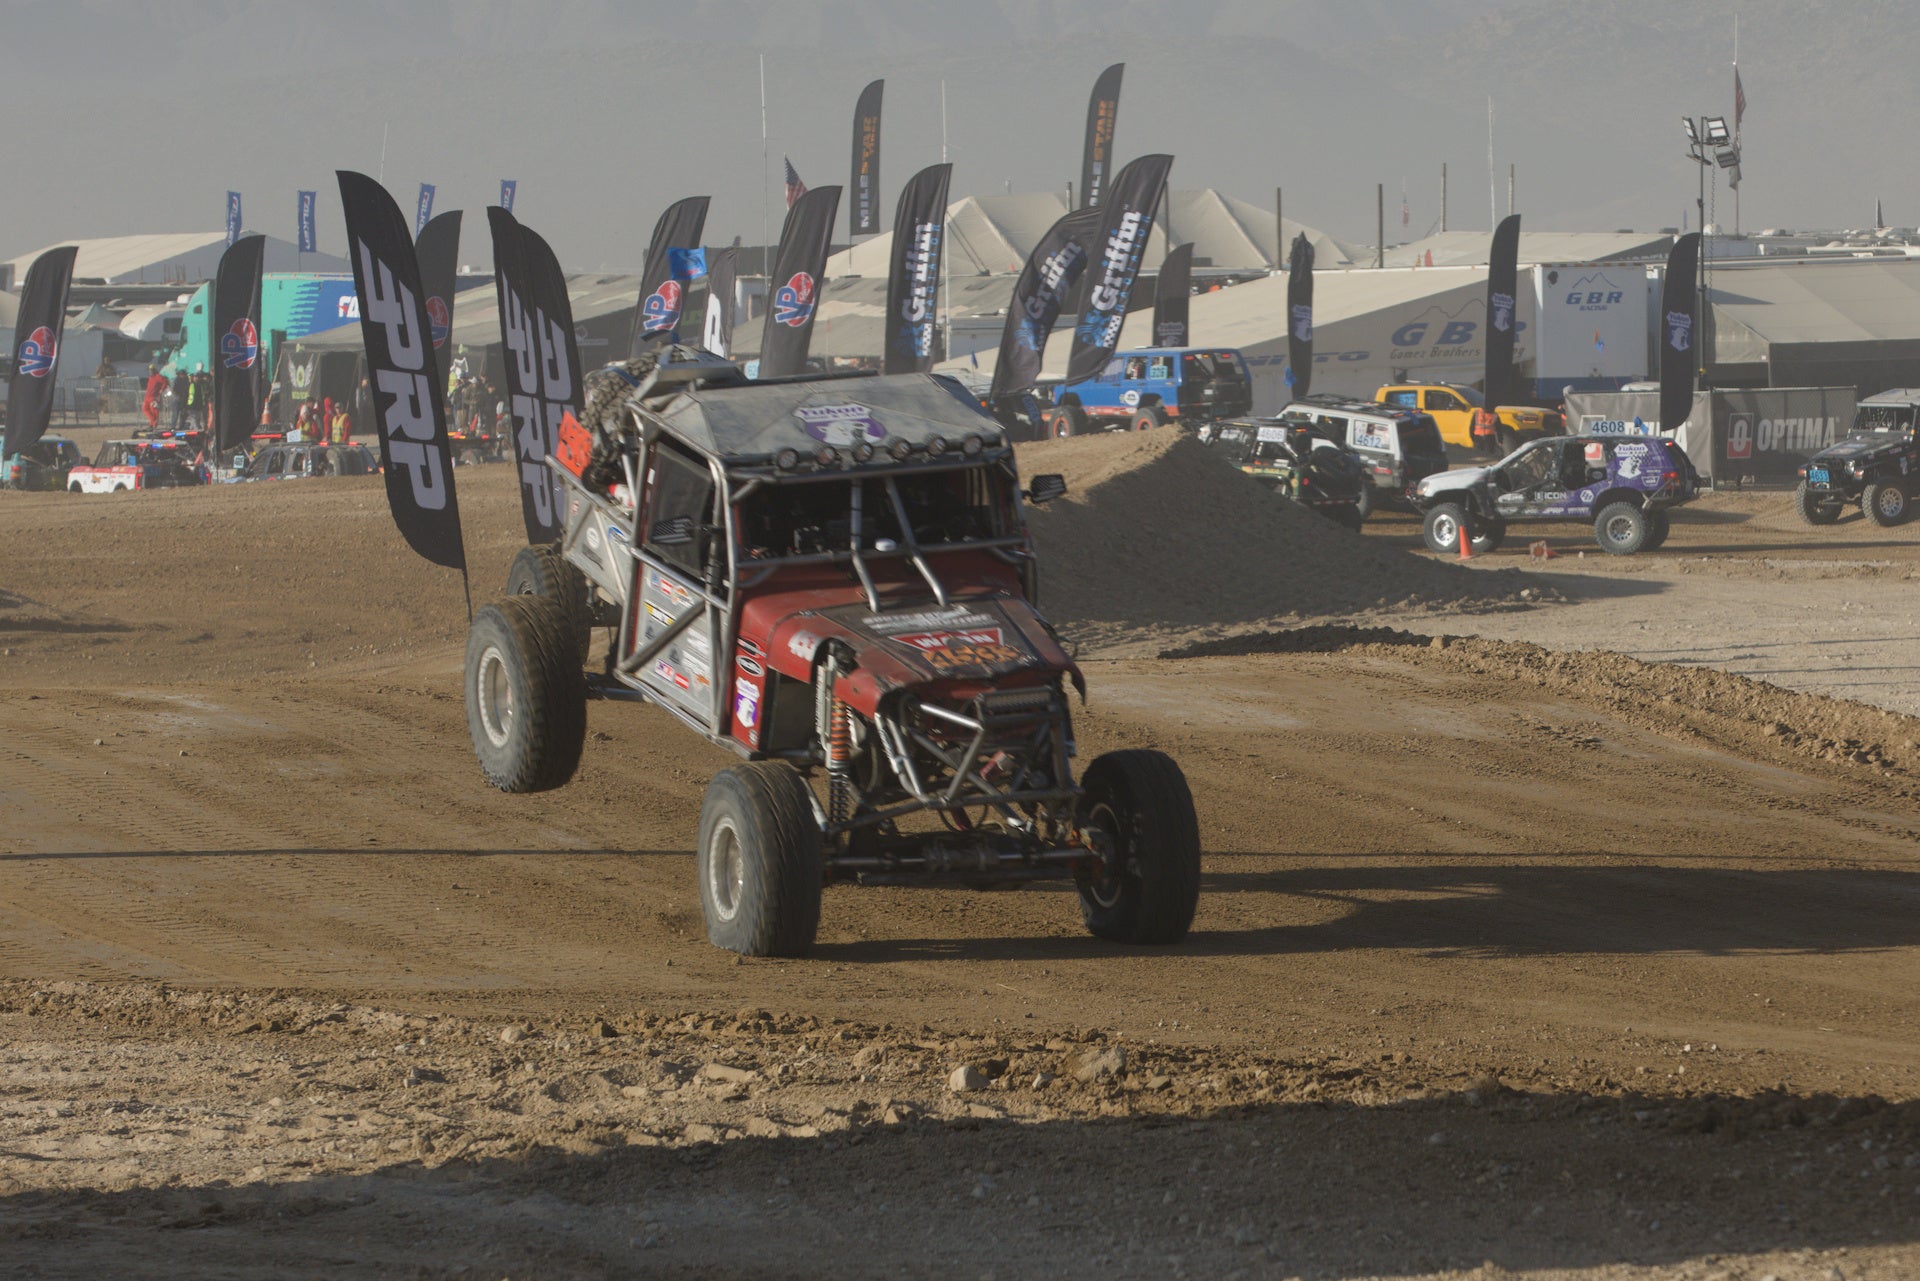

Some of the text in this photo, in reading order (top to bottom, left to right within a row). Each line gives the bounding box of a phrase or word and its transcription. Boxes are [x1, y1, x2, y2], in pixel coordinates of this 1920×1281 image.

[302, 194, 311, 250] FALKEN
[902, 221, 932, 322] Griffin
[1091, 211, 1141, 310] Griffin
[1024, 241, 1082, 320] Griffin
[642, 293, 681, 330] VP
[774, 285, 815, 323] VP
[19, 339, 56, 375] VP
[221, 332, 257, 368] VP
[1429, 346, 1481, 358] Brothers
[357, 235, 447, 511] PRP
[1592, 420, 1625, 433] 4608
[1756, 417, 1836, 451] OPTIMA
[1544, 491, 1567, 500] ICON
